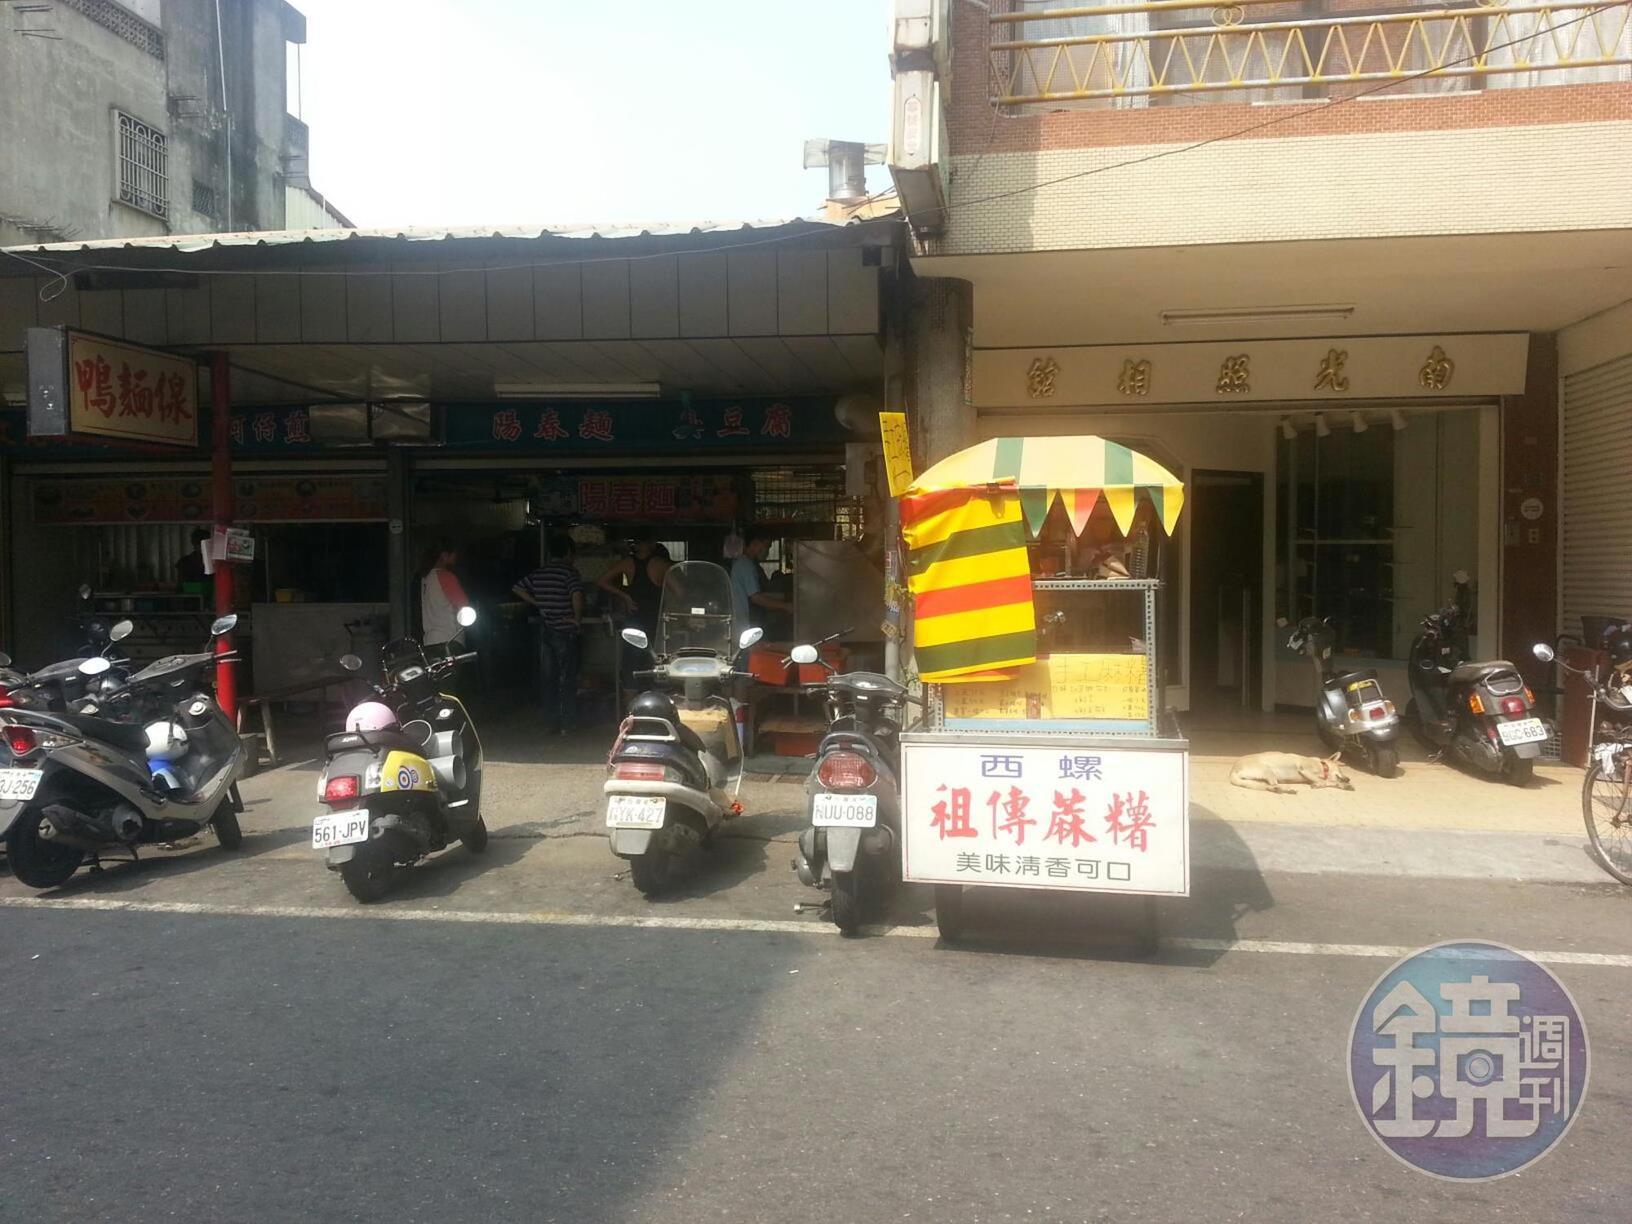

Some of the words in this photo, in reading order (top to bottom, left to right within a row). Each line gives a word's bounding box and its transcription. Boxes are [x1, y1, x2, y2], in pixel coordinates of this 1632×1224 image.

[979, 754, 1103, 781] 西螺
[314, 819, 367, 844] 561-JPV
[955, 851, 1132, 882] 美味清香可口
